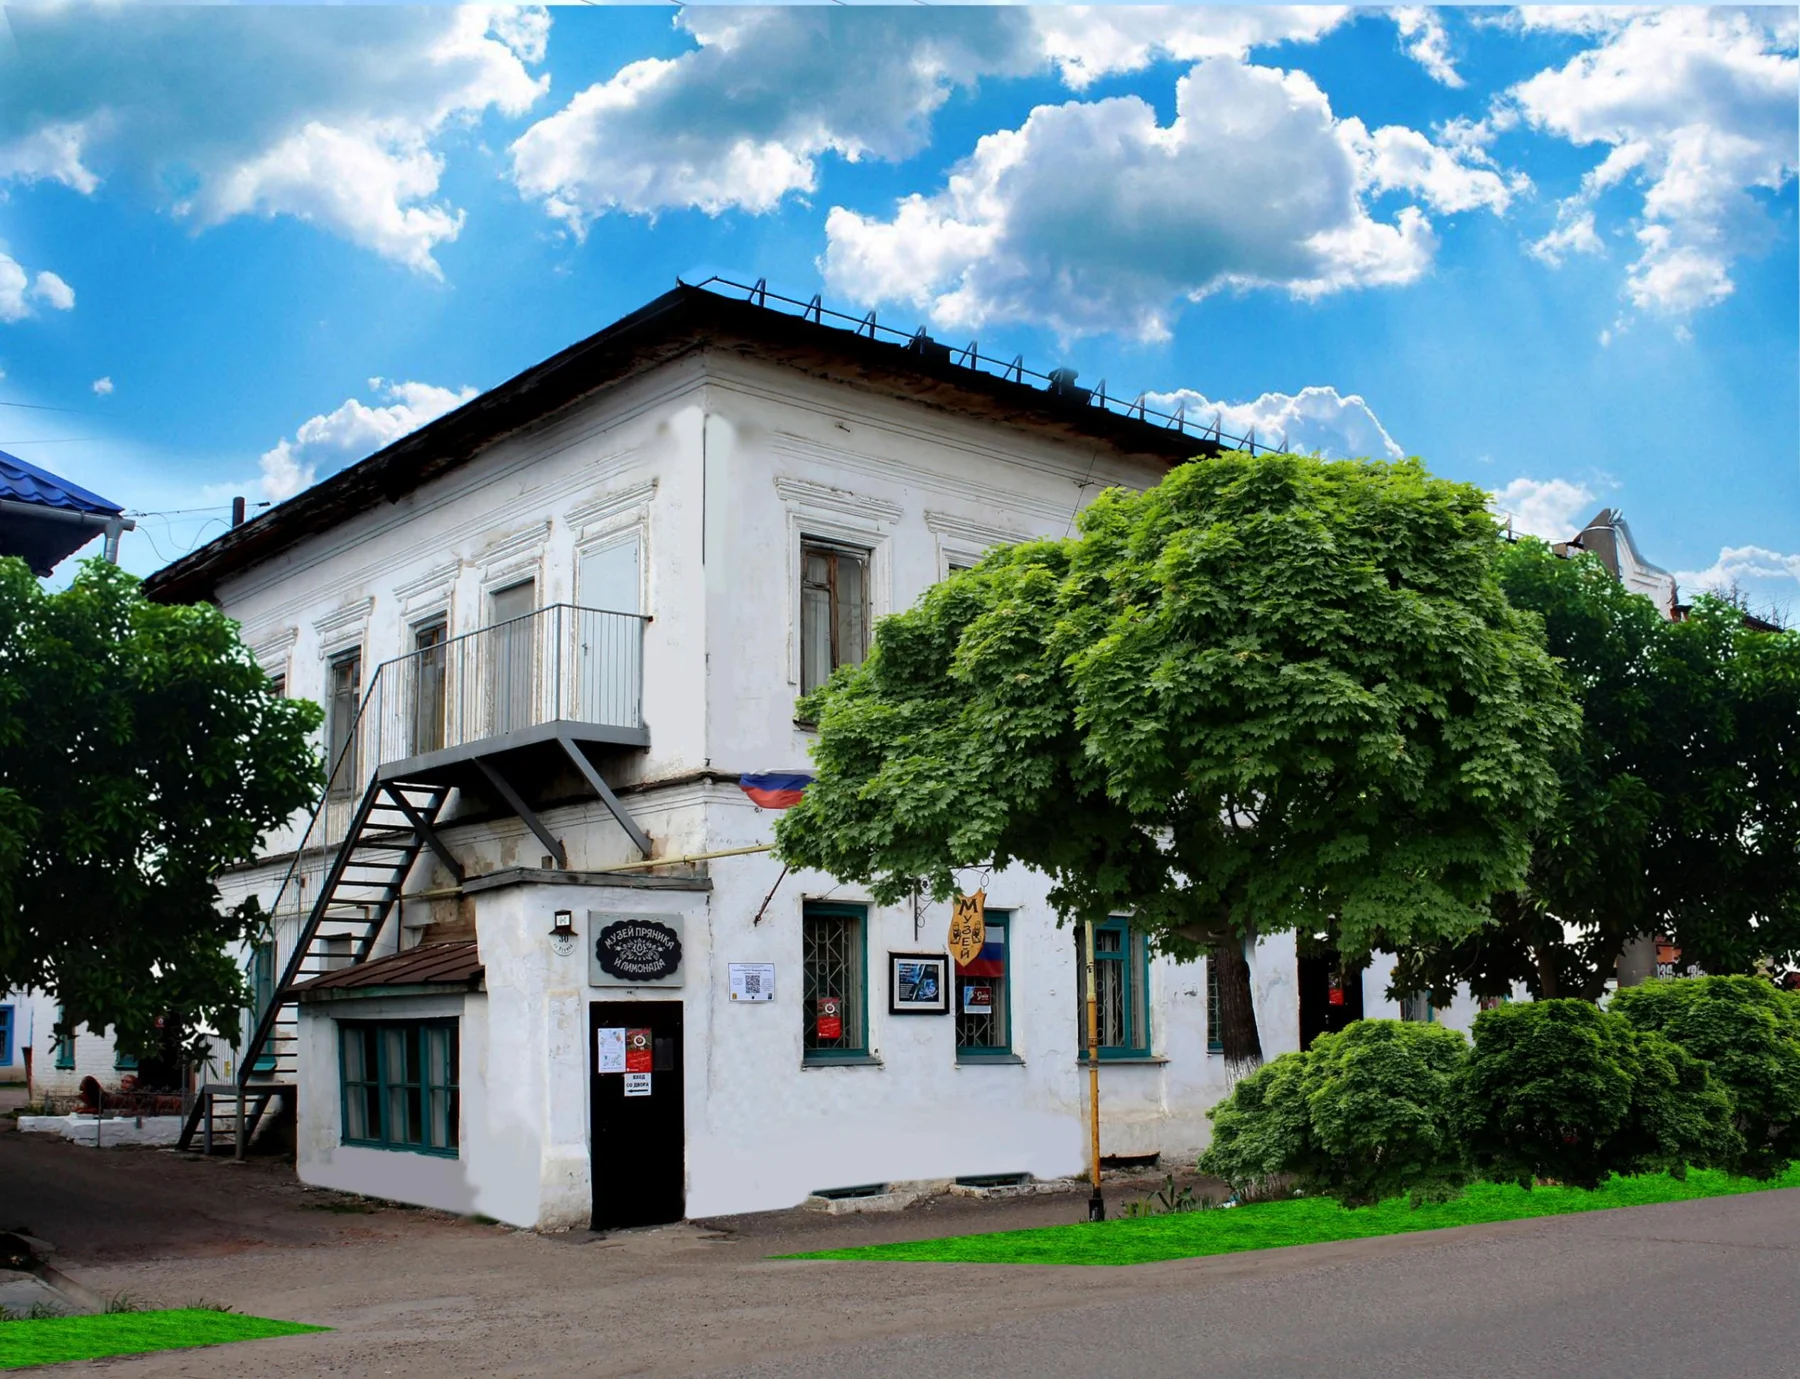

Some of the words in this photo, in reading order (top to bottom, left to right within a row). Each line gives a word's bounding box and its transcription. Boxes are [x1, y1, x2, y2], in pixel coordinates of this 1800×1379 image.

[558, 934, 569, 944] 30
[604, 926, 635, 950] МУЗЕЙ
[635, 927, 675, 950] ПРЯНИКА
[613, 957, 621, 968] И
[621, 958, 666, 973] ЛИМОНАДА
